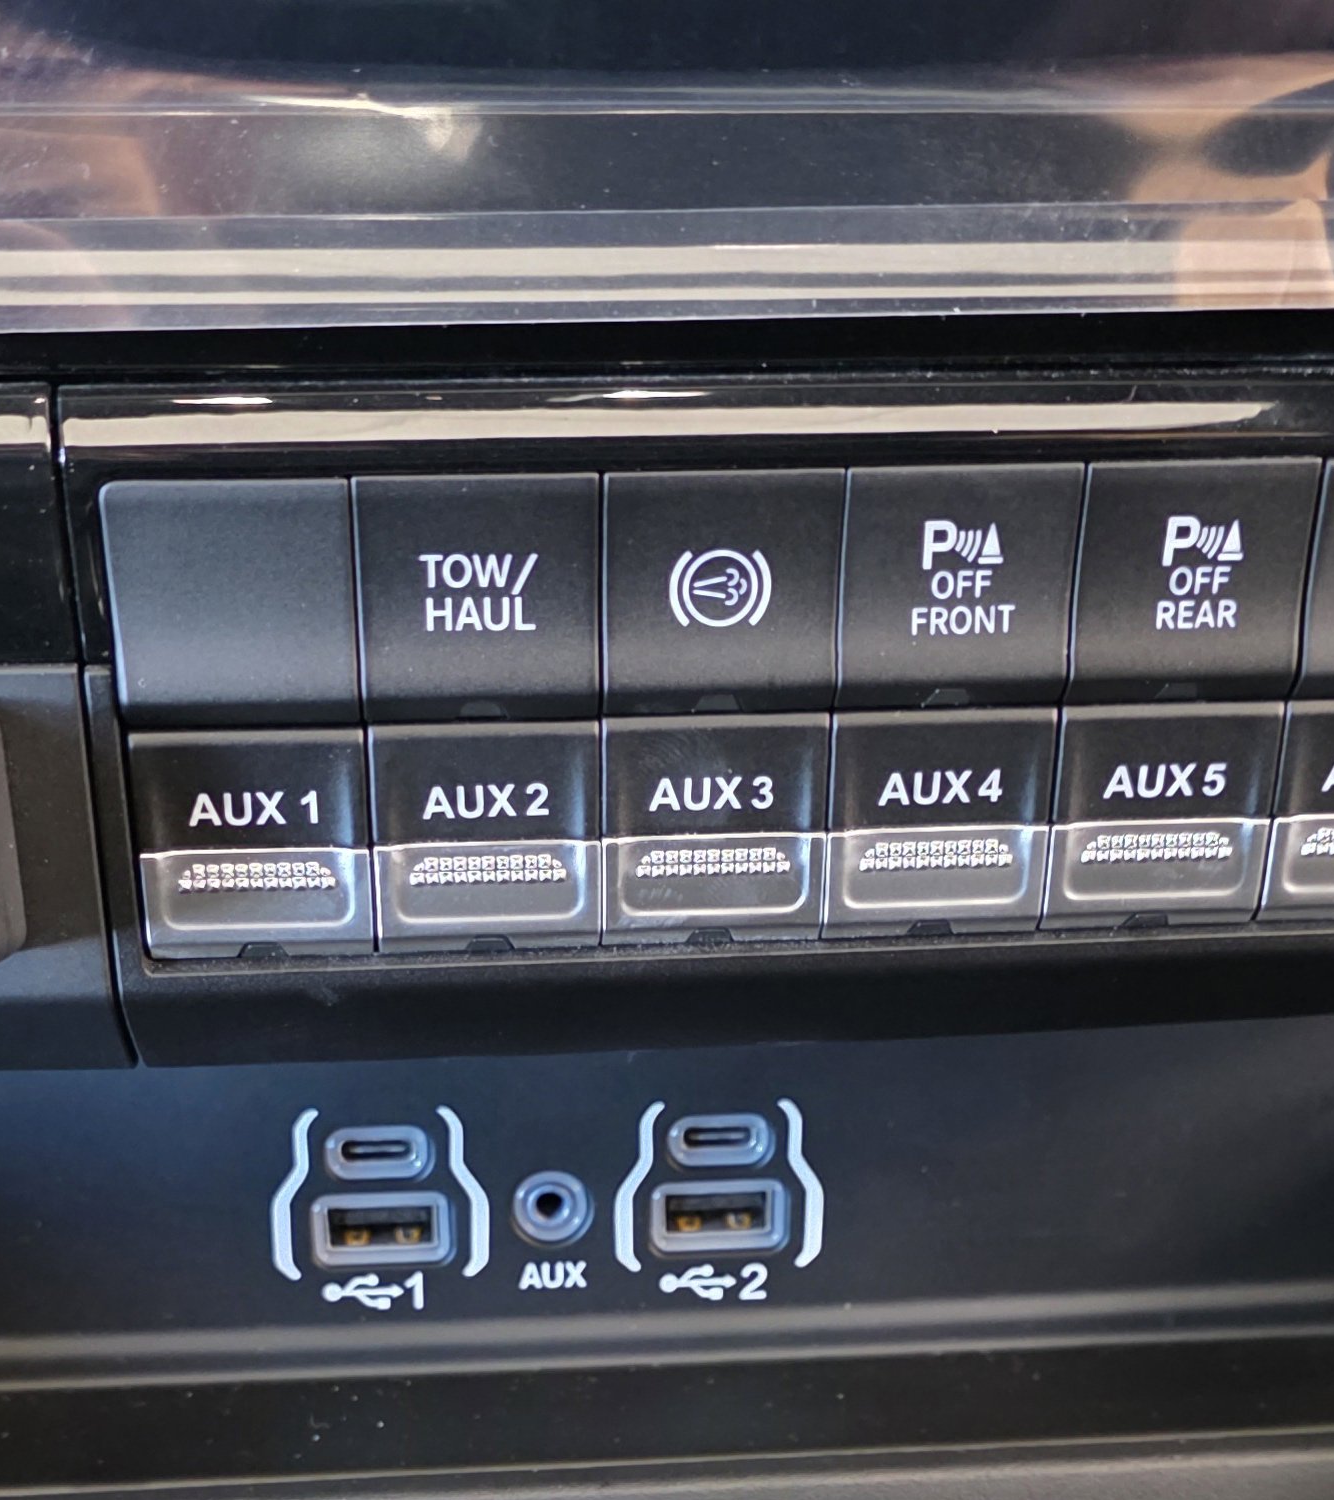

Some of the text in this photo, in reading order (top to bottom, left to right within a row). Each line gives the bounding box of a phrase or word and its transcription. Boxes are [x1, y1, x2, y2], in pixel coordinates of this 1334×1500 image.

[418, 553, 538, 596] TOW/
[931, 569, 993, 600] OFF
[1169, 565, 1231, 596] OFF
[425, 596, 537, 632] HAUL
[911, 604, 1016, 636] FRONT
[1155, 599, 1237, 630] REAR
[648, 775, 774, 812] AUX 3
[877, 768, 1003, 807] AUX 4
[1102, 762, 1227, 799] AUX 5
[189, 790, 319, 827] AUX 1
[422, 782, 550, 820] AUX 2
[406, 1271, 424, 1310] 1
[519, 1260, 587, 1290] AUX
[739, 1263, 768, 1301] 2
